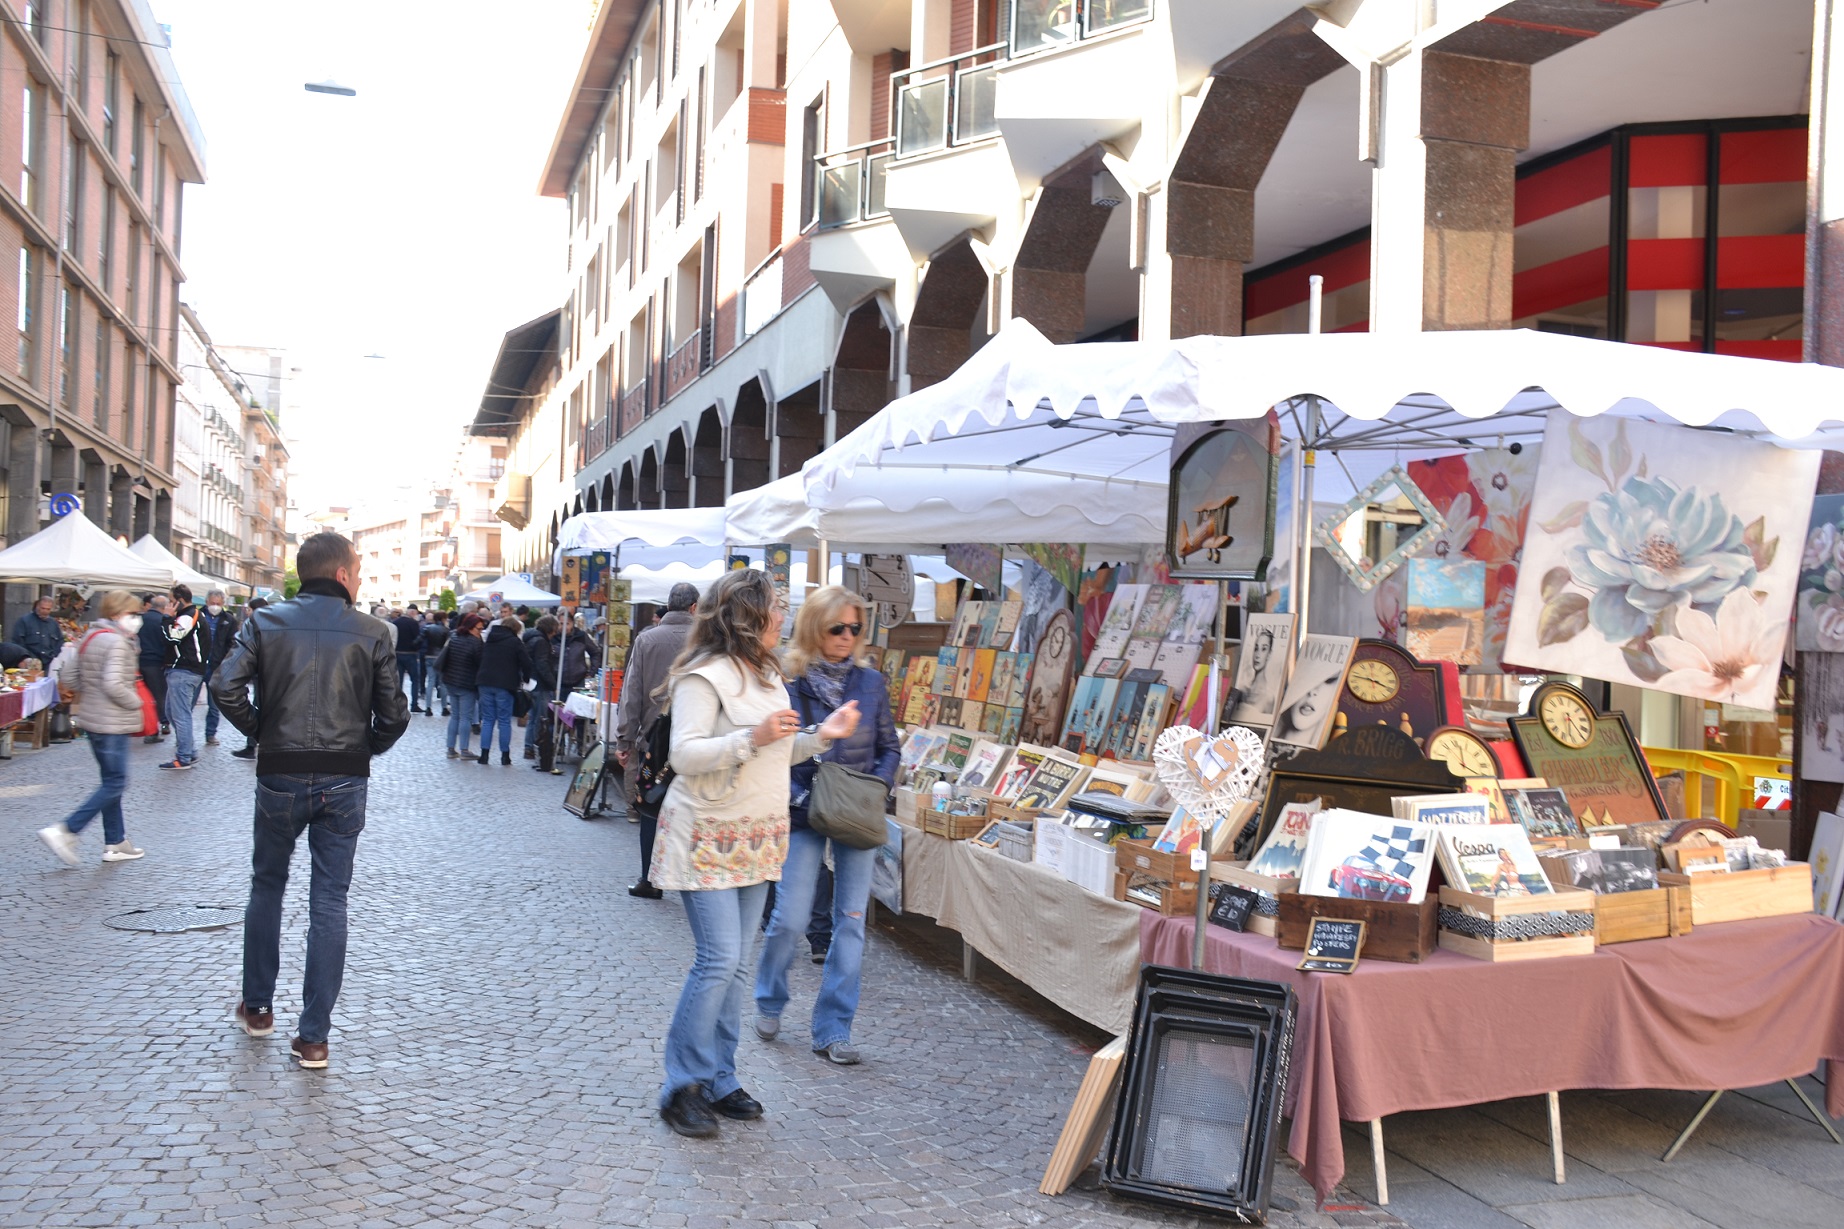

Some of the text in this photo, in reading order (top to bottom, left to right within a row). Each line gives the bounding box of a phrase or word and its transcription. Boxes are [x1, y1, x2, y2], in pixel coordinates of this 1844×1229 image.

[1302, 640, 1350, 664] VOGUE
[1540, 754, 1644, 799] CHANDLERS
[1452, 836, 1497, 858] Vespa
